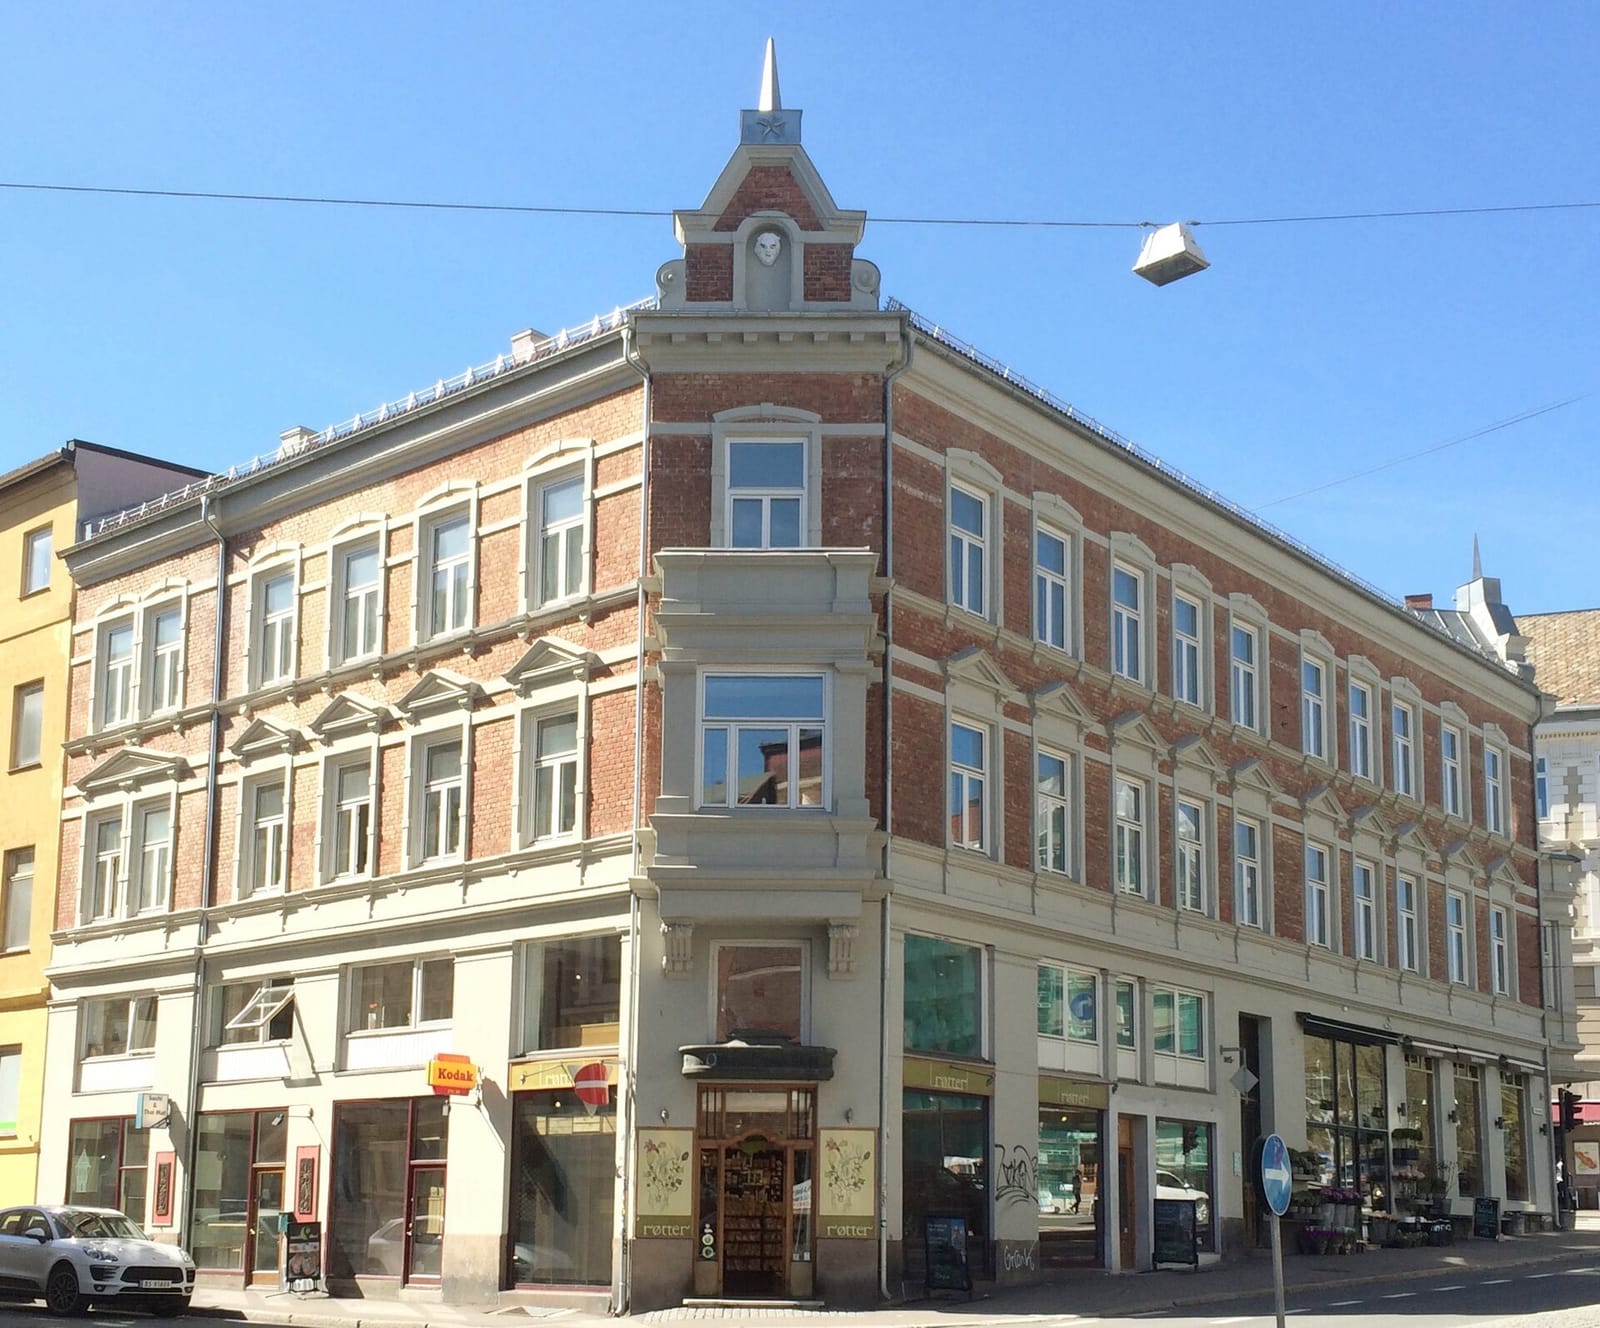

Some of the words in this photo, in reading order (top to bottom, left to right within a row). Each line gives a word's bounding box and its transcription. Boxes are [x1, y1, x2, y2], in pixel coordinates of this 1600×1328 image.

[438, 1067, 474, 1082] Kodak
[643, 1224, 690, 1236] røtter
[827, 1224, 874, 1236] røtter
